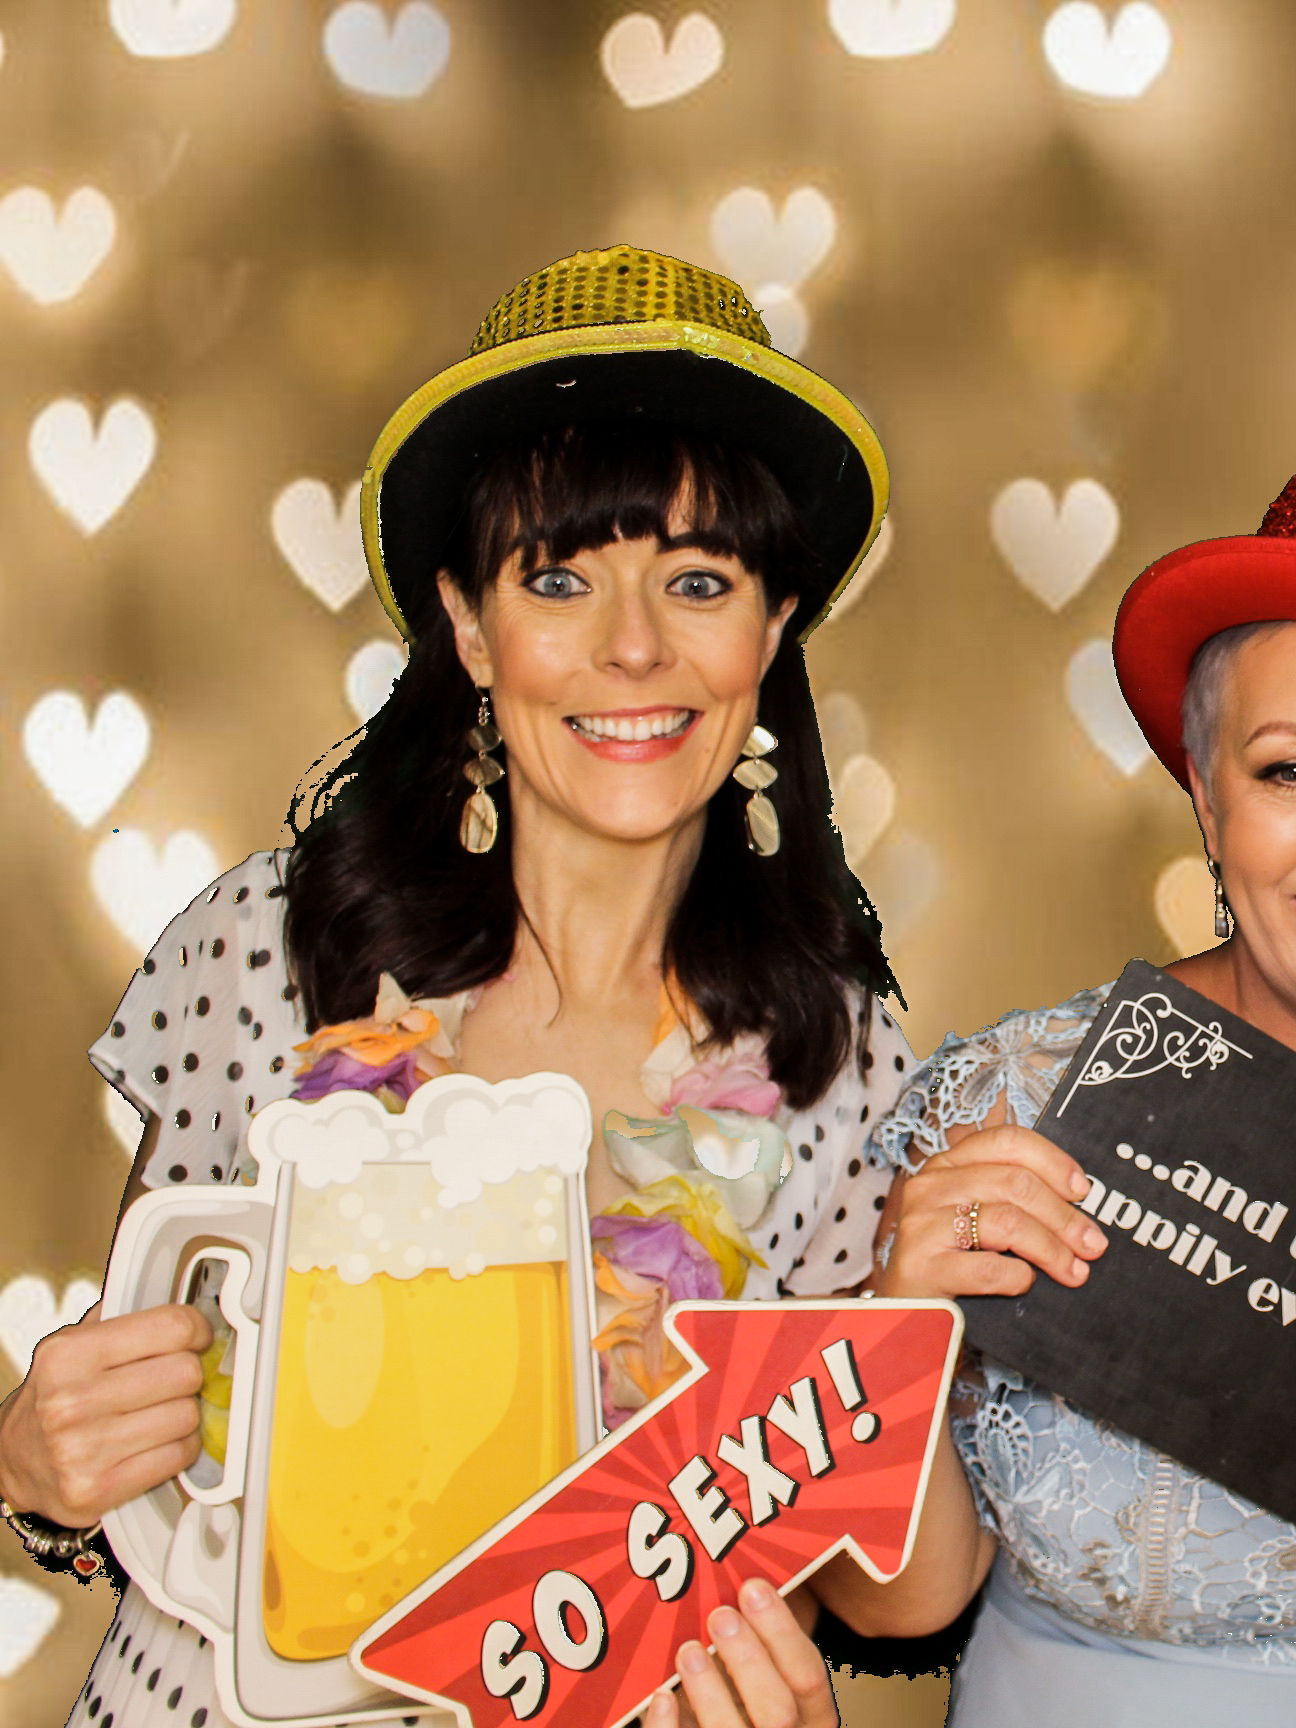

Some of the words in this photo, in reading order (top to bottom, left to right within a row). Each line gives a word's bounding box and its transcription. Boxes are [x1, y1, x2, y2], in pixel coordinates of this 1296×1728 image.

[1074, 1173, 1247, 1285] appily
[1115, 1142, 1288, 1242] ...and
[481, 1569, 605, 1720] SO
[626, 1338, 880, 1601] SEXY!
